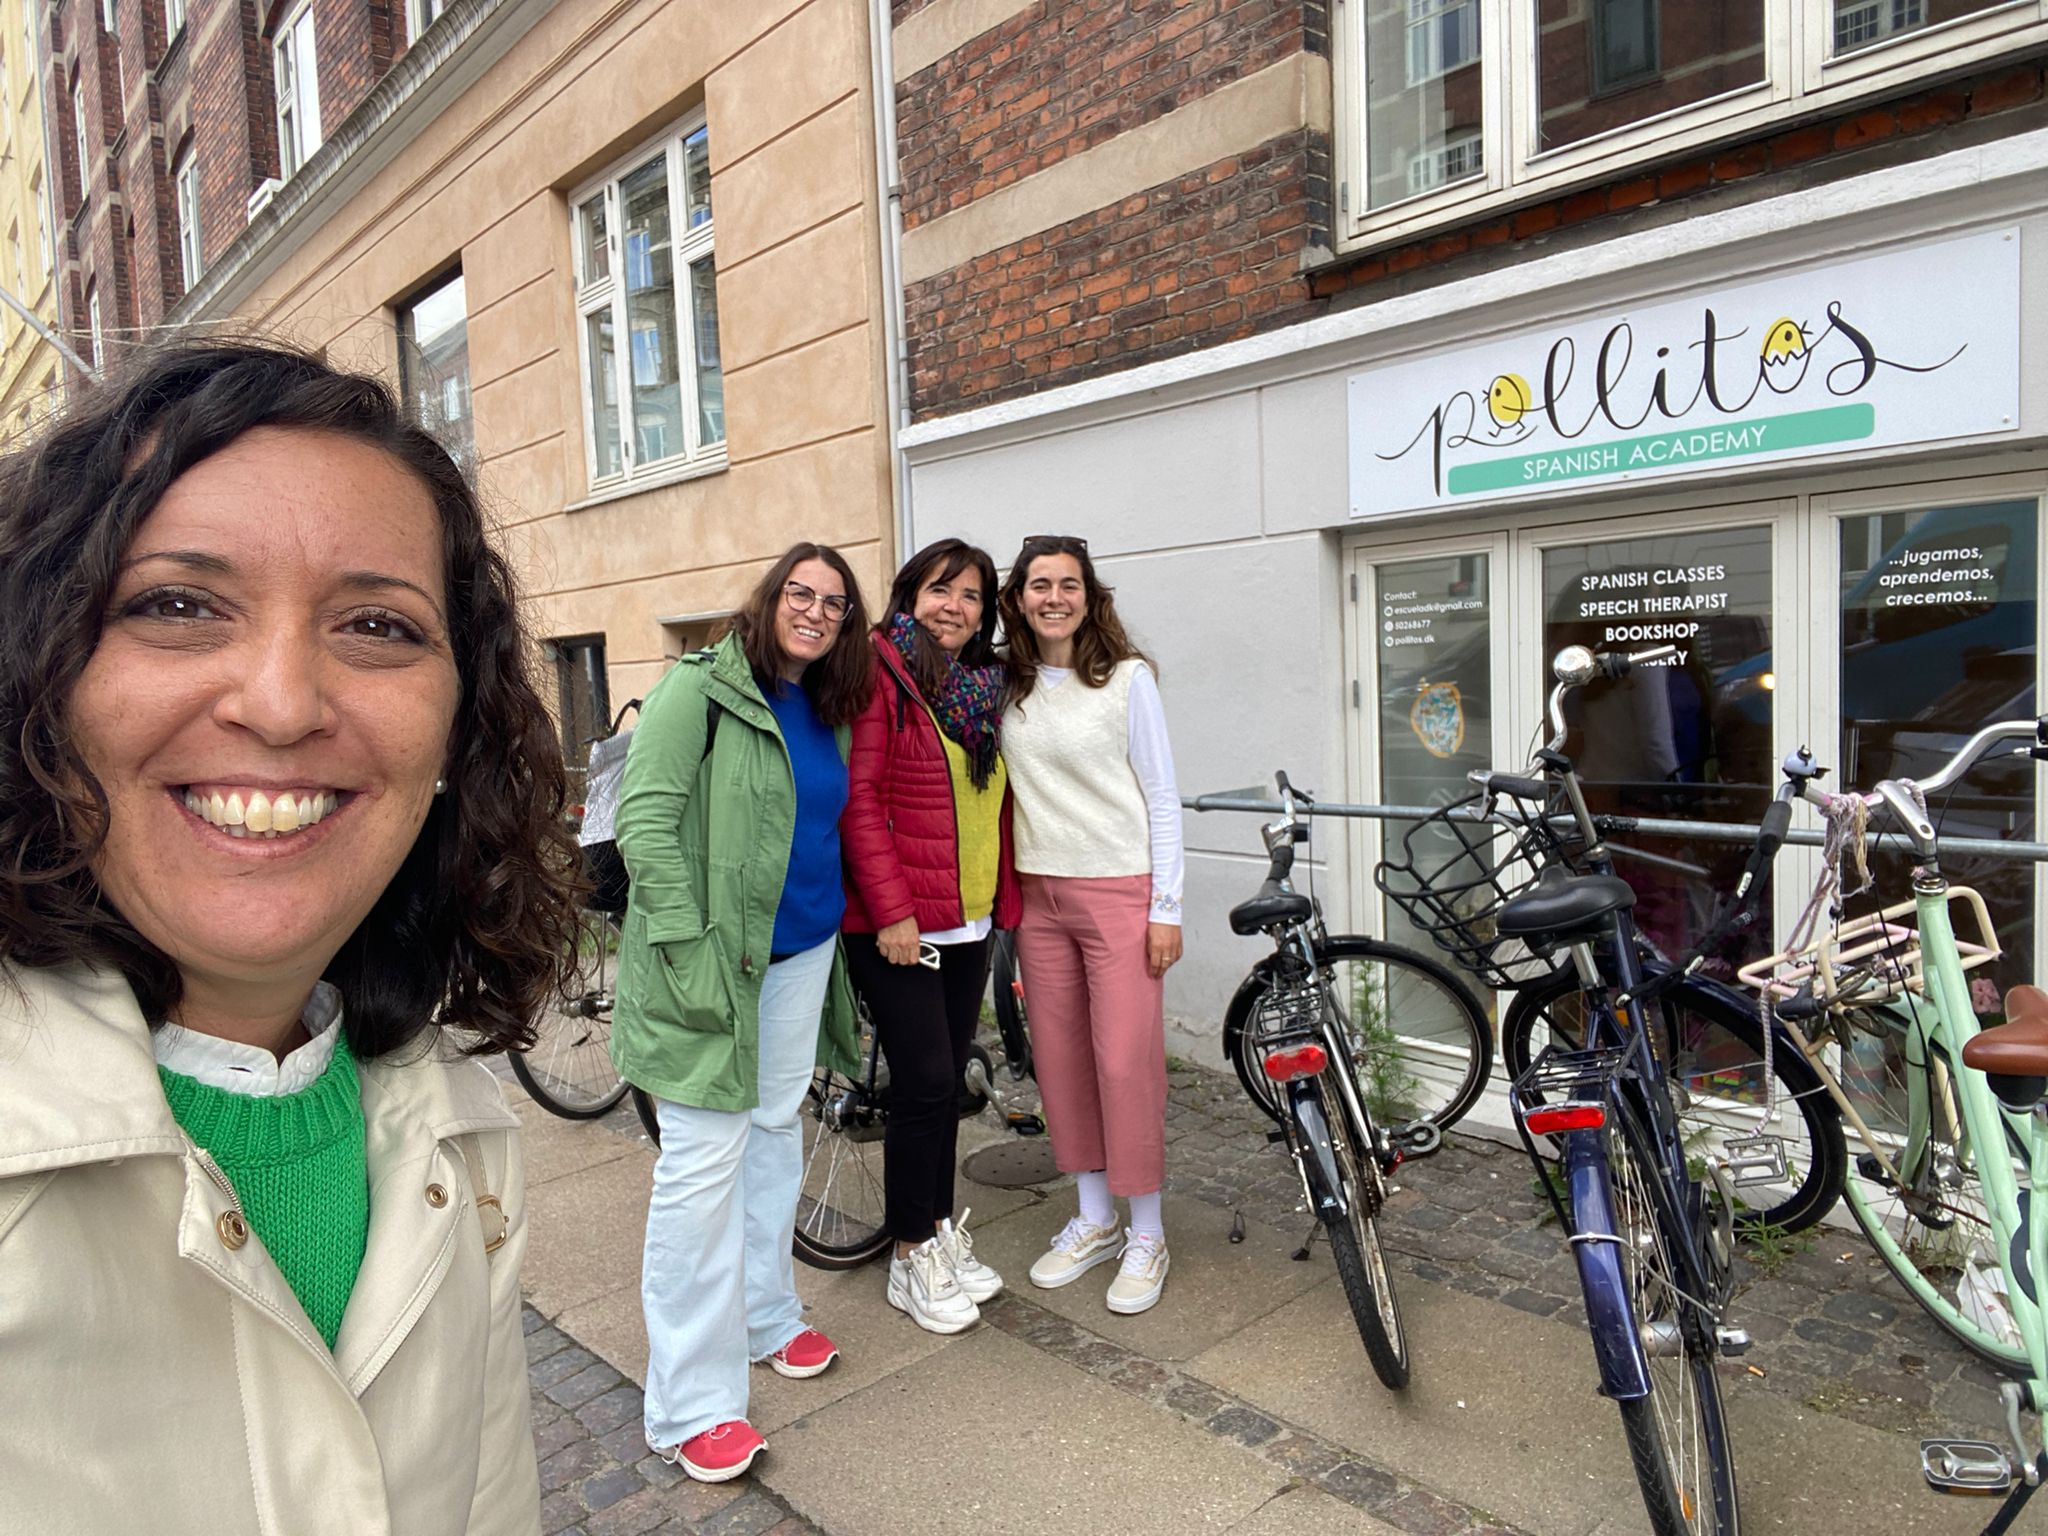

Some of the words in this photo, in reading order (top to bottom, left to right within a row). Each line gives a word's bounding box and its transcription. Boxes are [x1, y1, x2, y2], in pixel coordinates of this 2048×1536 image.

[1374, 300, 1969, 498] pollitos
[1522, 449, 1619, 480] SPANISH
[1628, 425, 1768, 467] ACADEMY
[1889, 547, 1984, 567] ...jugamos,
[1581, 572, 1648, 591] SPANISH
[1653, 565, 1726, 585] CLASSES
[1879, 568, 1994, 588] aprendemos,
[1580, 600, 1639, 617] SPEECH
[1643, 593, 1728, 613] THERAPIST
[1885, 590, 1988, 606] crecemos...
[1605, 623, 1700, 642] BOOKSHOP
